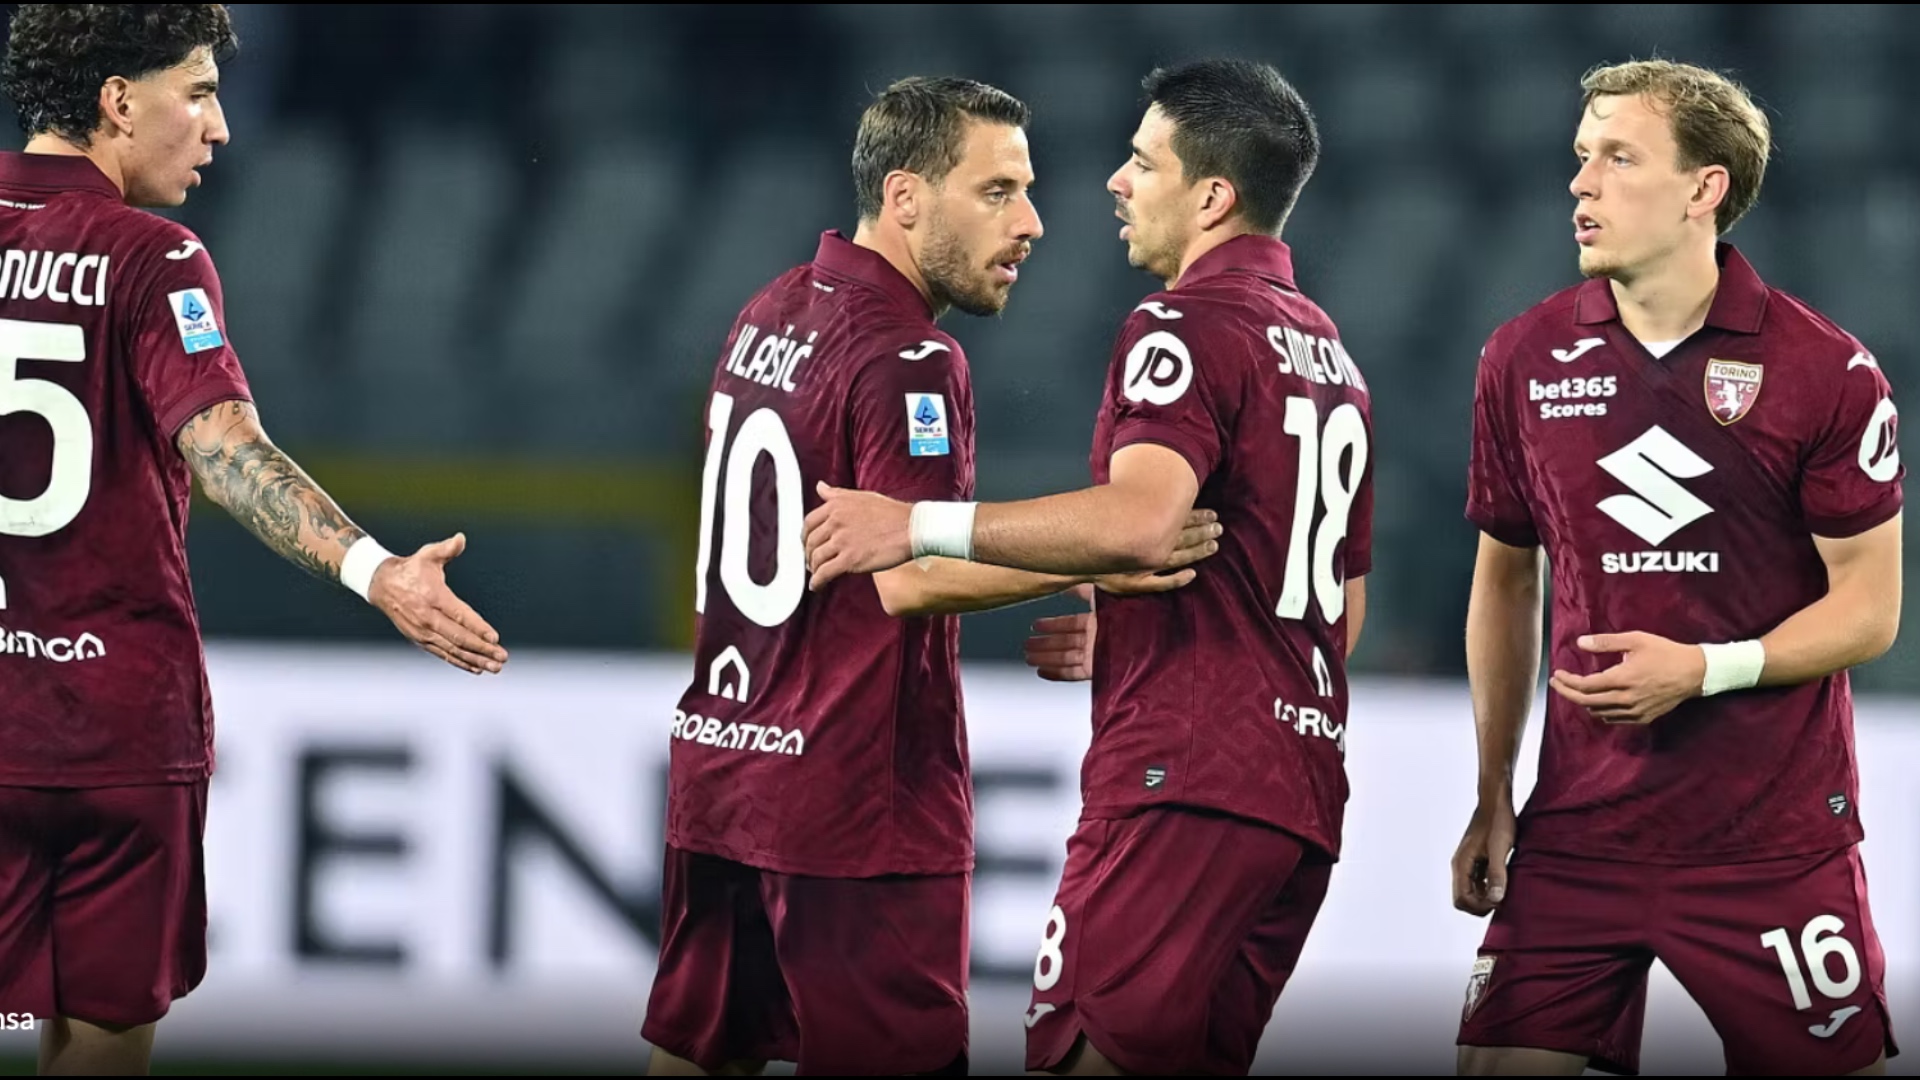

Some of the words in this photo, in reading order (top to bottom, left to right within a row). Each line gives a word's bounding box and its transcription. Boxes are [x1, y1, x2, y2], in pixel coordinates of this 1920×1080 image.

[0, 249, 110, 306] NUCCI
[1529, 376, 1618, 401] bet365
[1713, 365, 1757, 379] TORINO
[1738, 382, 1755, 393] FC
[0, 318, 93, 537] 5
[1540, 402, 1607, 419] Scores
[695, 391, 806, 627] 10
[1275, 396, 1368, 625] 18
[1601, 551, 1719, 574] SUZUKI
[1760, 914, 1861, 1011] 16
